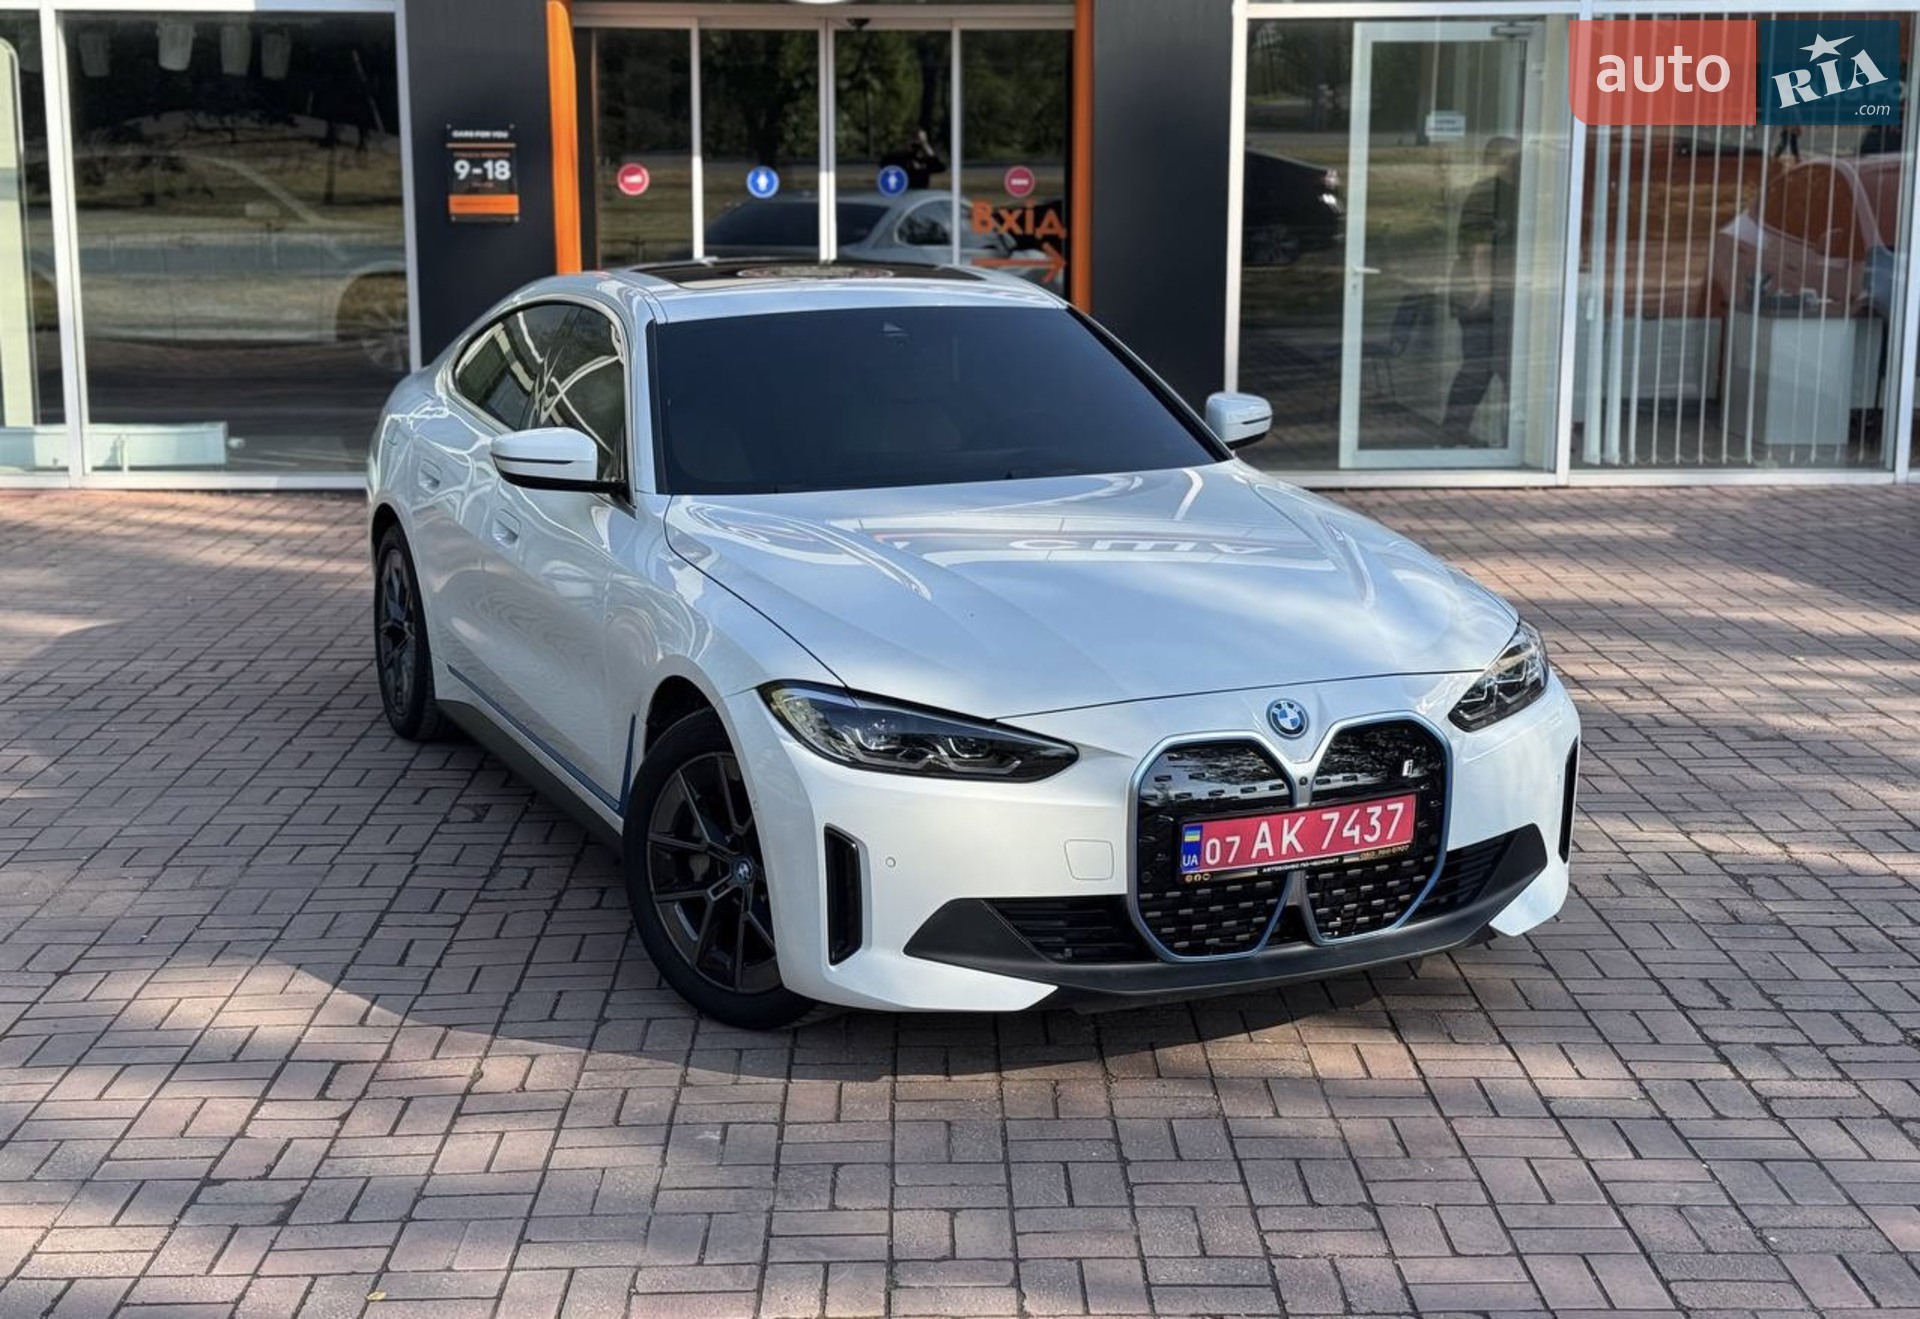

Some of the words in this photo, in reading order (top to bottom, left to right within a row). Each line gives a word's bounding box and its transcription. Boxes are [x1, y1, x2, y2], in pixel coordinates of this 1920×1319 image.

[454, 159, 511, 180] 9-18
[1205, 836, 1241, 866] 07
[1250, 816, 1306, 859] AK
[1321, 803, 1404, 850] 7437
[1182, 854, 1199, 867] UA
